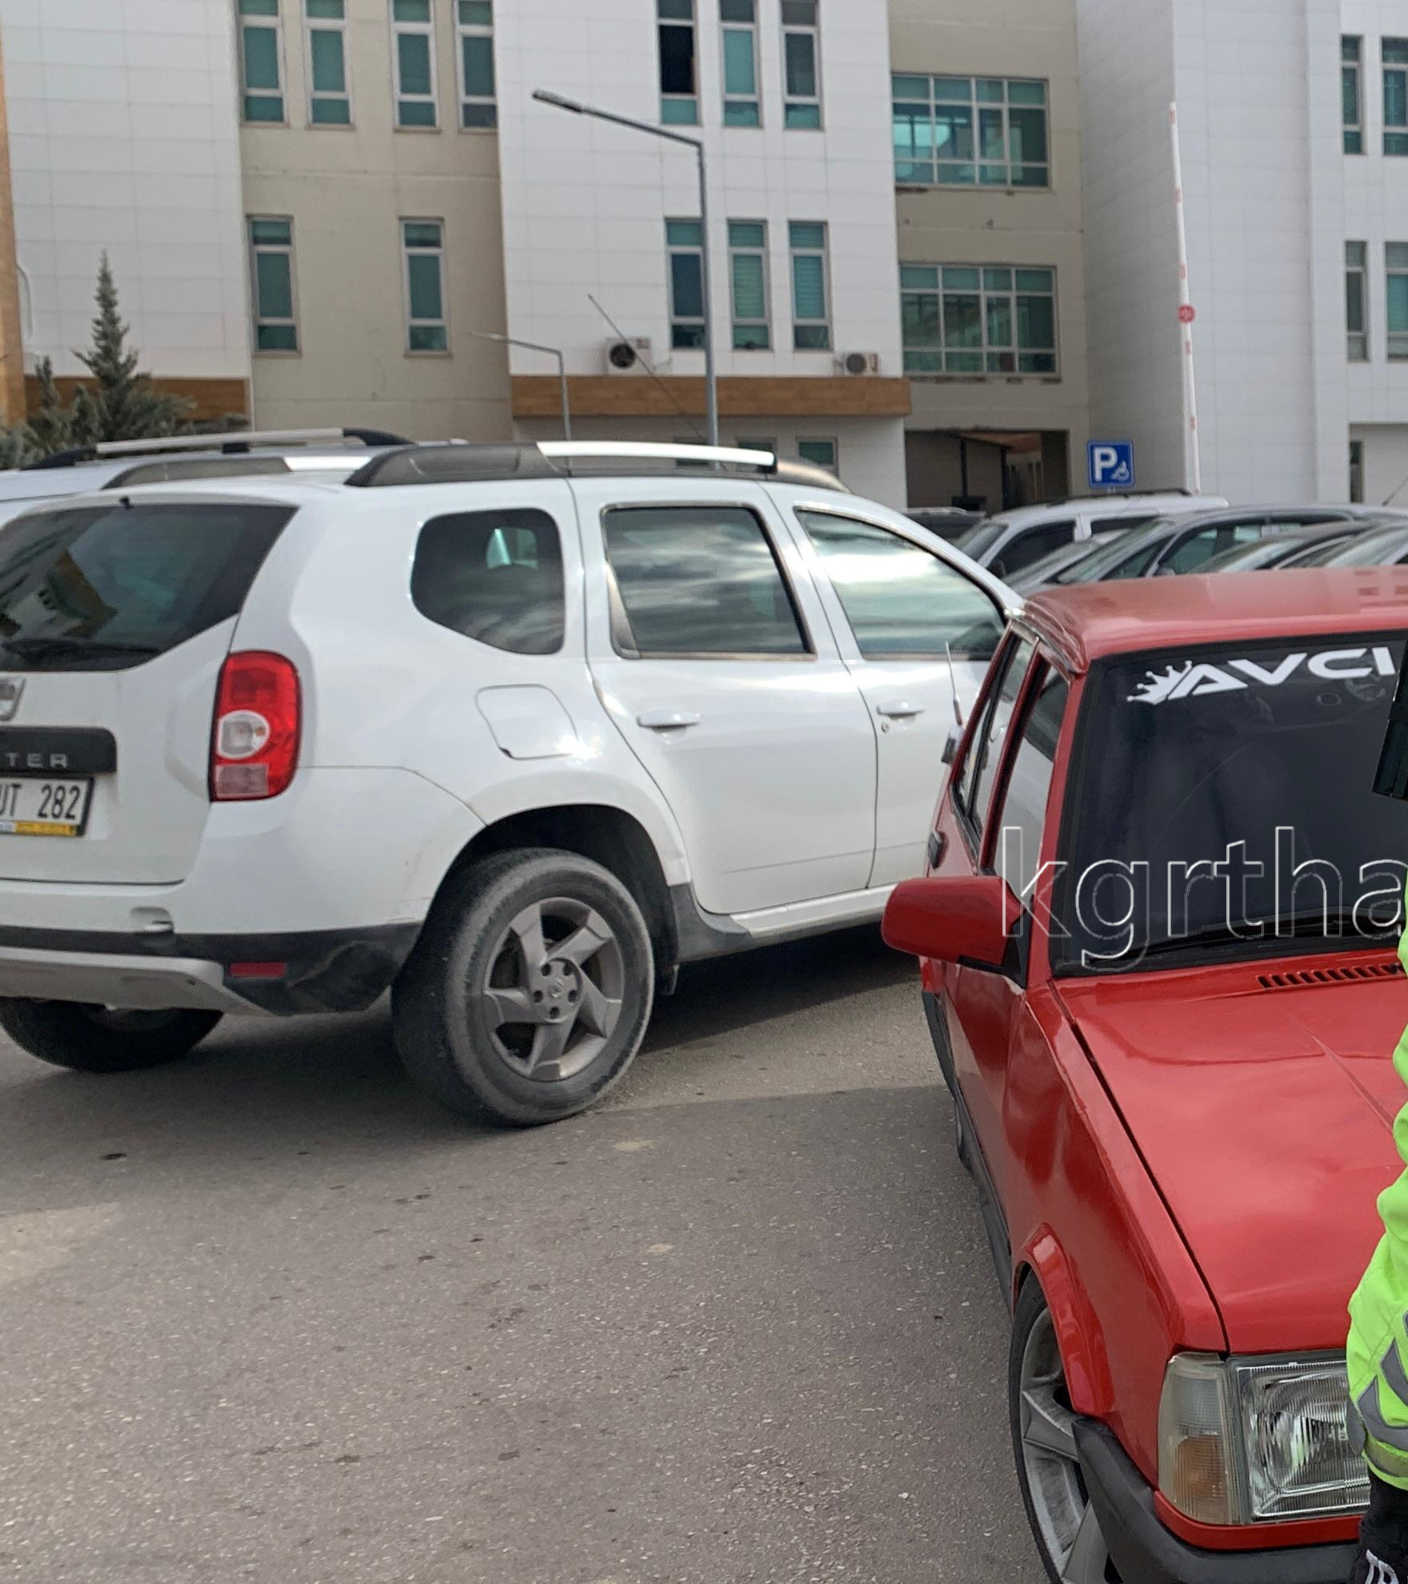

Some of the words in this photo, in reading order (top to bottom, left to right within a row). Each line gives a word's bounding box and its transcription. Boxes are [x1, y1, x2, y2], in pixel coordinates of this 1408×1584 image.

[1093, 446, 1118, 482] P
[1167, 646, 1396, 700] AVCI
[38, 784, 81, 820] 282
